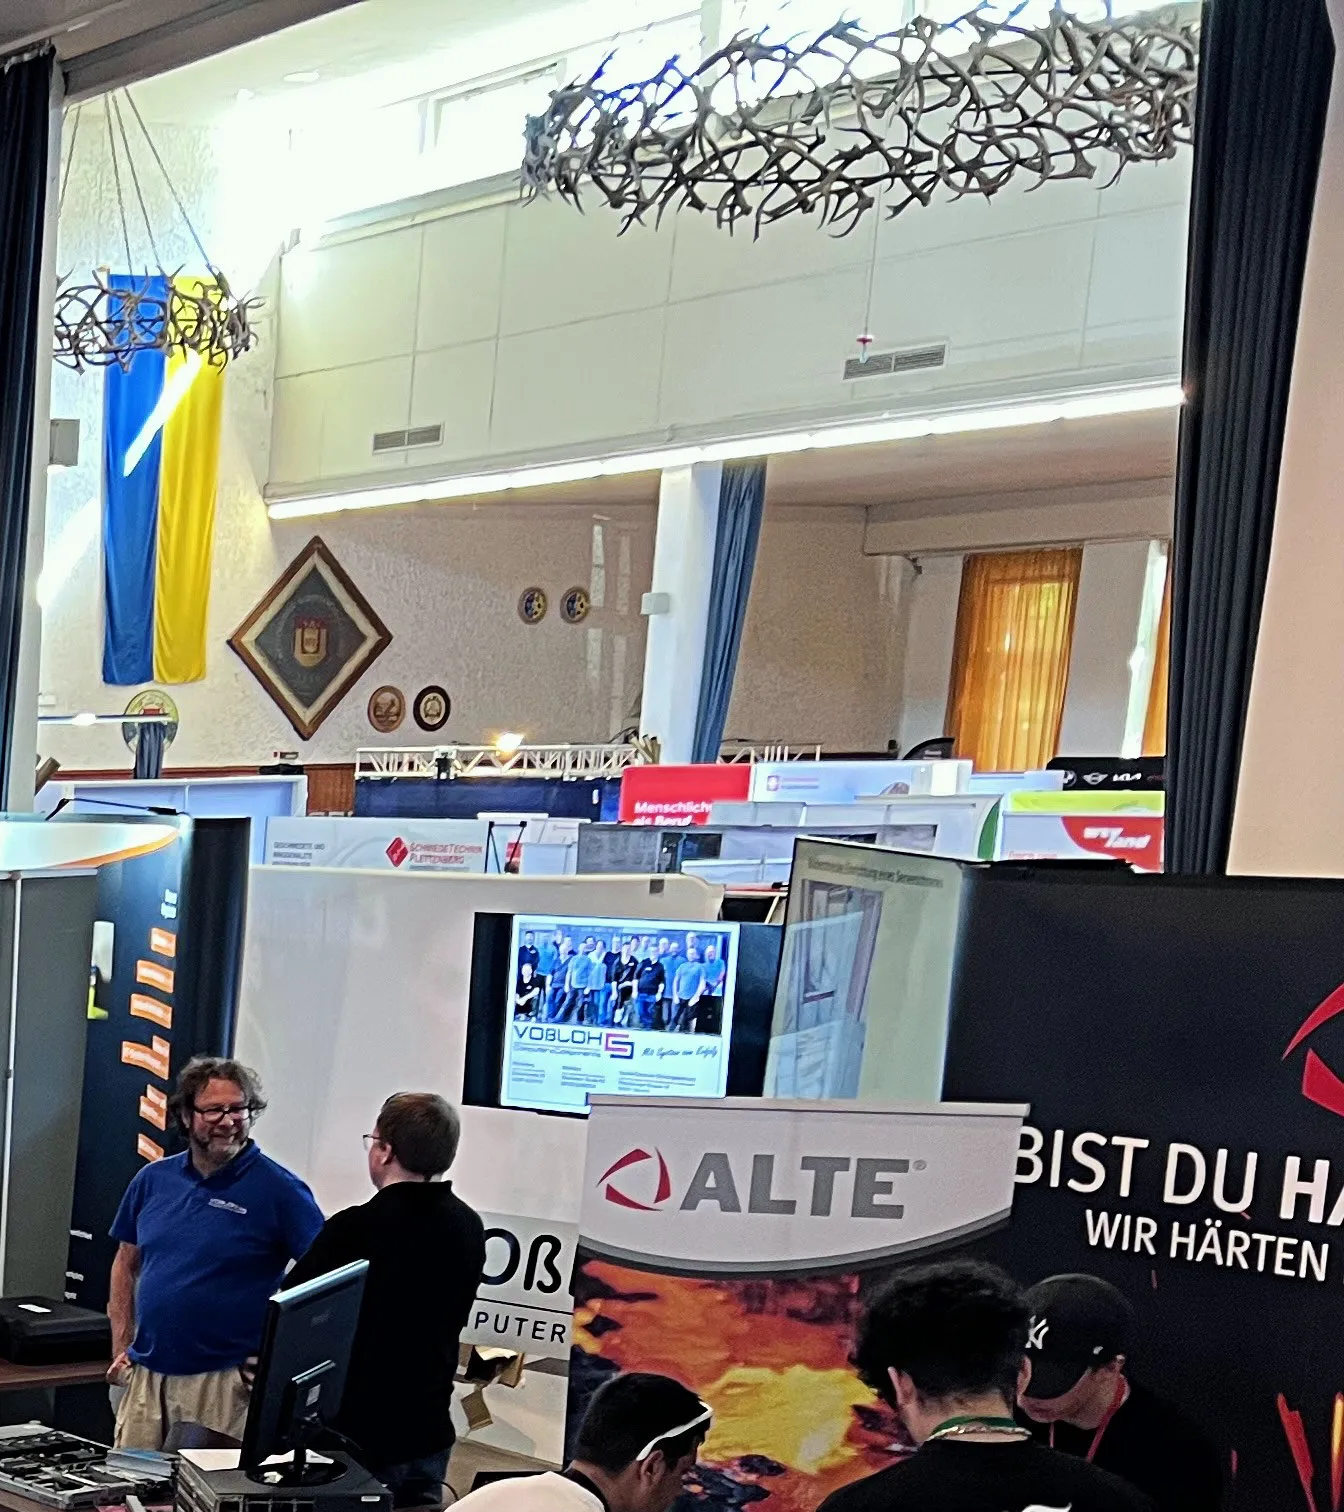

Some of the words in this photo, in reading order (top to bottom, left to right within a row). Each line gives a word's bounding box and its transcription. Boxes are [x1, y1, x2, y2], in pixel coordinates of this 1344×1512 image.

[1014, 1125, 1150, 1198] BIST
[1163, 1142, 1258, 1214] DU
[1085, 1209, 1157, 1255] WIR
[1169, 1218, 1329, 1282] HÄRTEN
[474, 1311, 566, 1343] PUTER
